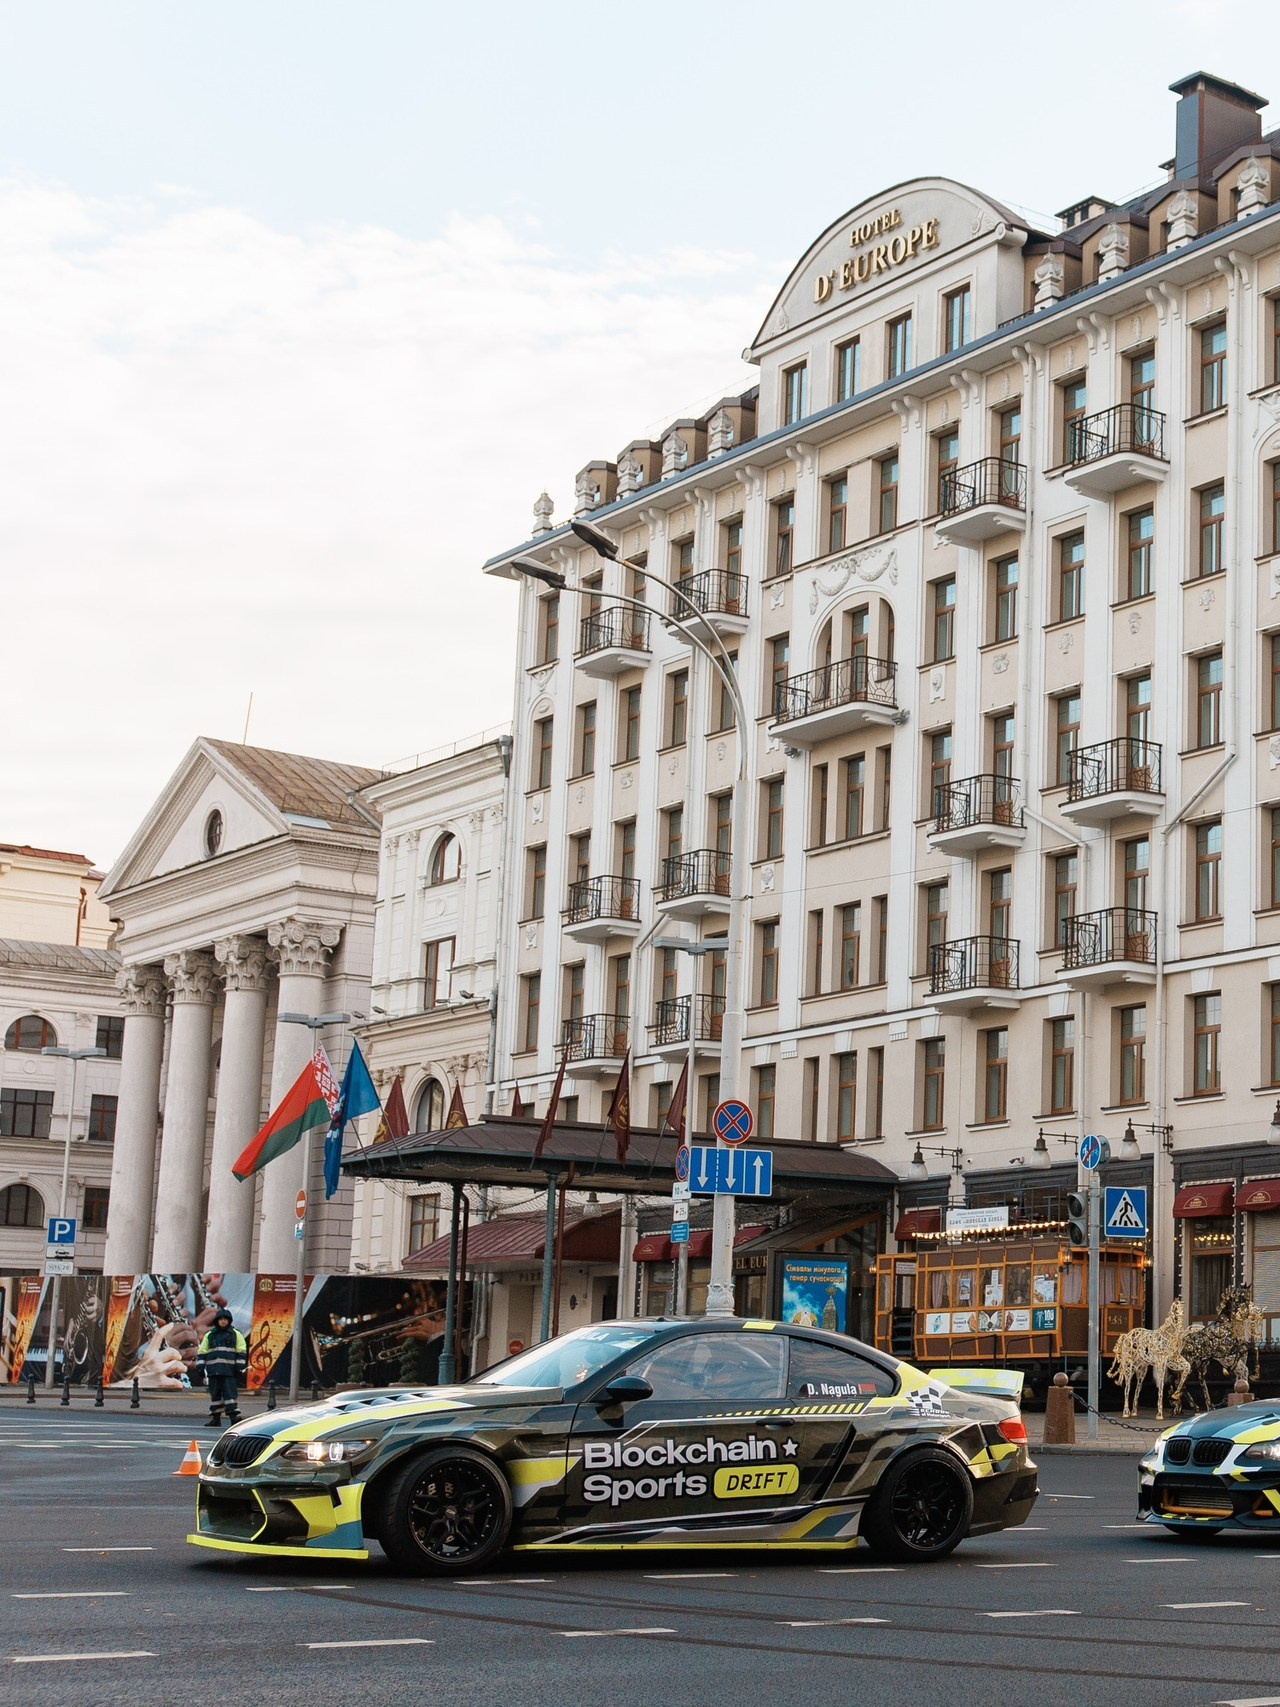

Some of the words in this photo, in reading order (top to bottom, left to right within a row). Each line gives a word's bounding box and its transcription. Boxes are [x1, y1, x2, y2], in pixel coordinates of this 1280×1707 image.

[850, 208, 902, 248] HOTEL
[54, 1220, 71, 1241] P
[807, 1383, 818, 1395] D.
[821, 1383, 857, 1397] Nagula
[584, 1435, 777, 1469] Blockchain
[583, 1471, 707, 1506] Sports
[726, 1472, 788, 1491] DRIFT
